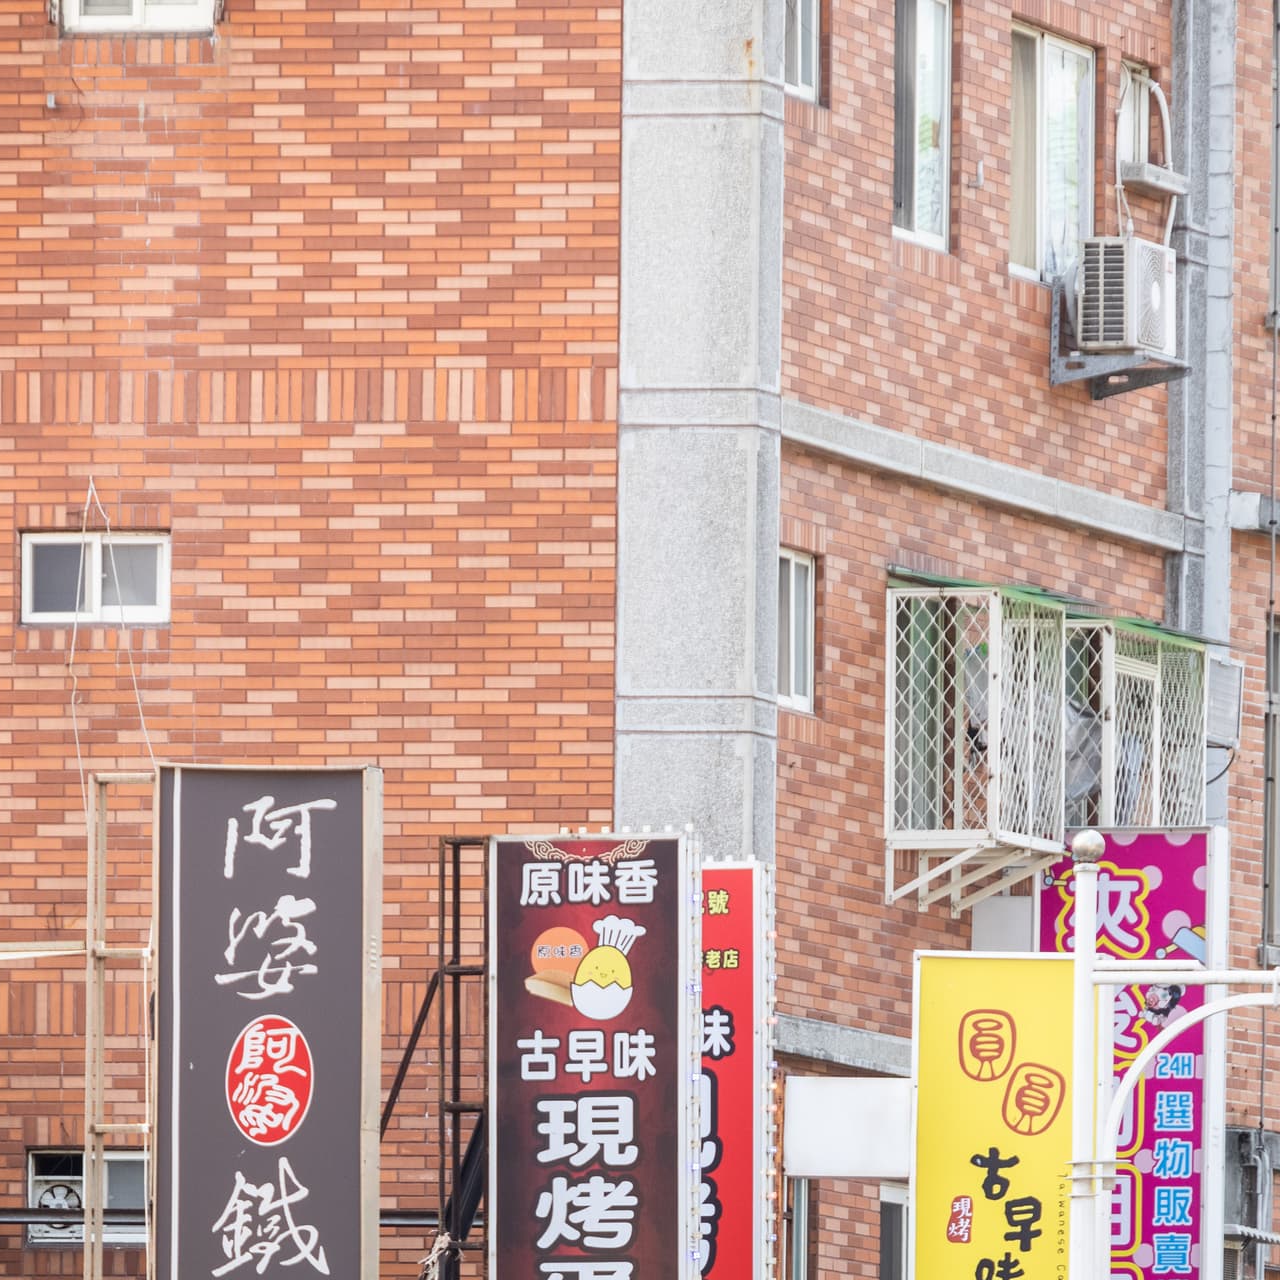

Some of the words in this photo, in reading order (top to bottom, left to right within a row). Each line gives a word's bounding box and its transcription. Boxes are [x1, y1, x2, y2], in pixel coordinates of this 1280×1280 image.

[520, 860, 658, 907] 原味香
[700, 889, 729, 915] 號
[536, 944, 584, 961] 原味香
[698, 949, 740, 970] 老店
[517, 1029, 658, 1084] 古早味
[1157, 1054, 1193, 1079] 24H
[946, 1196, 972, 1243] 現烤
